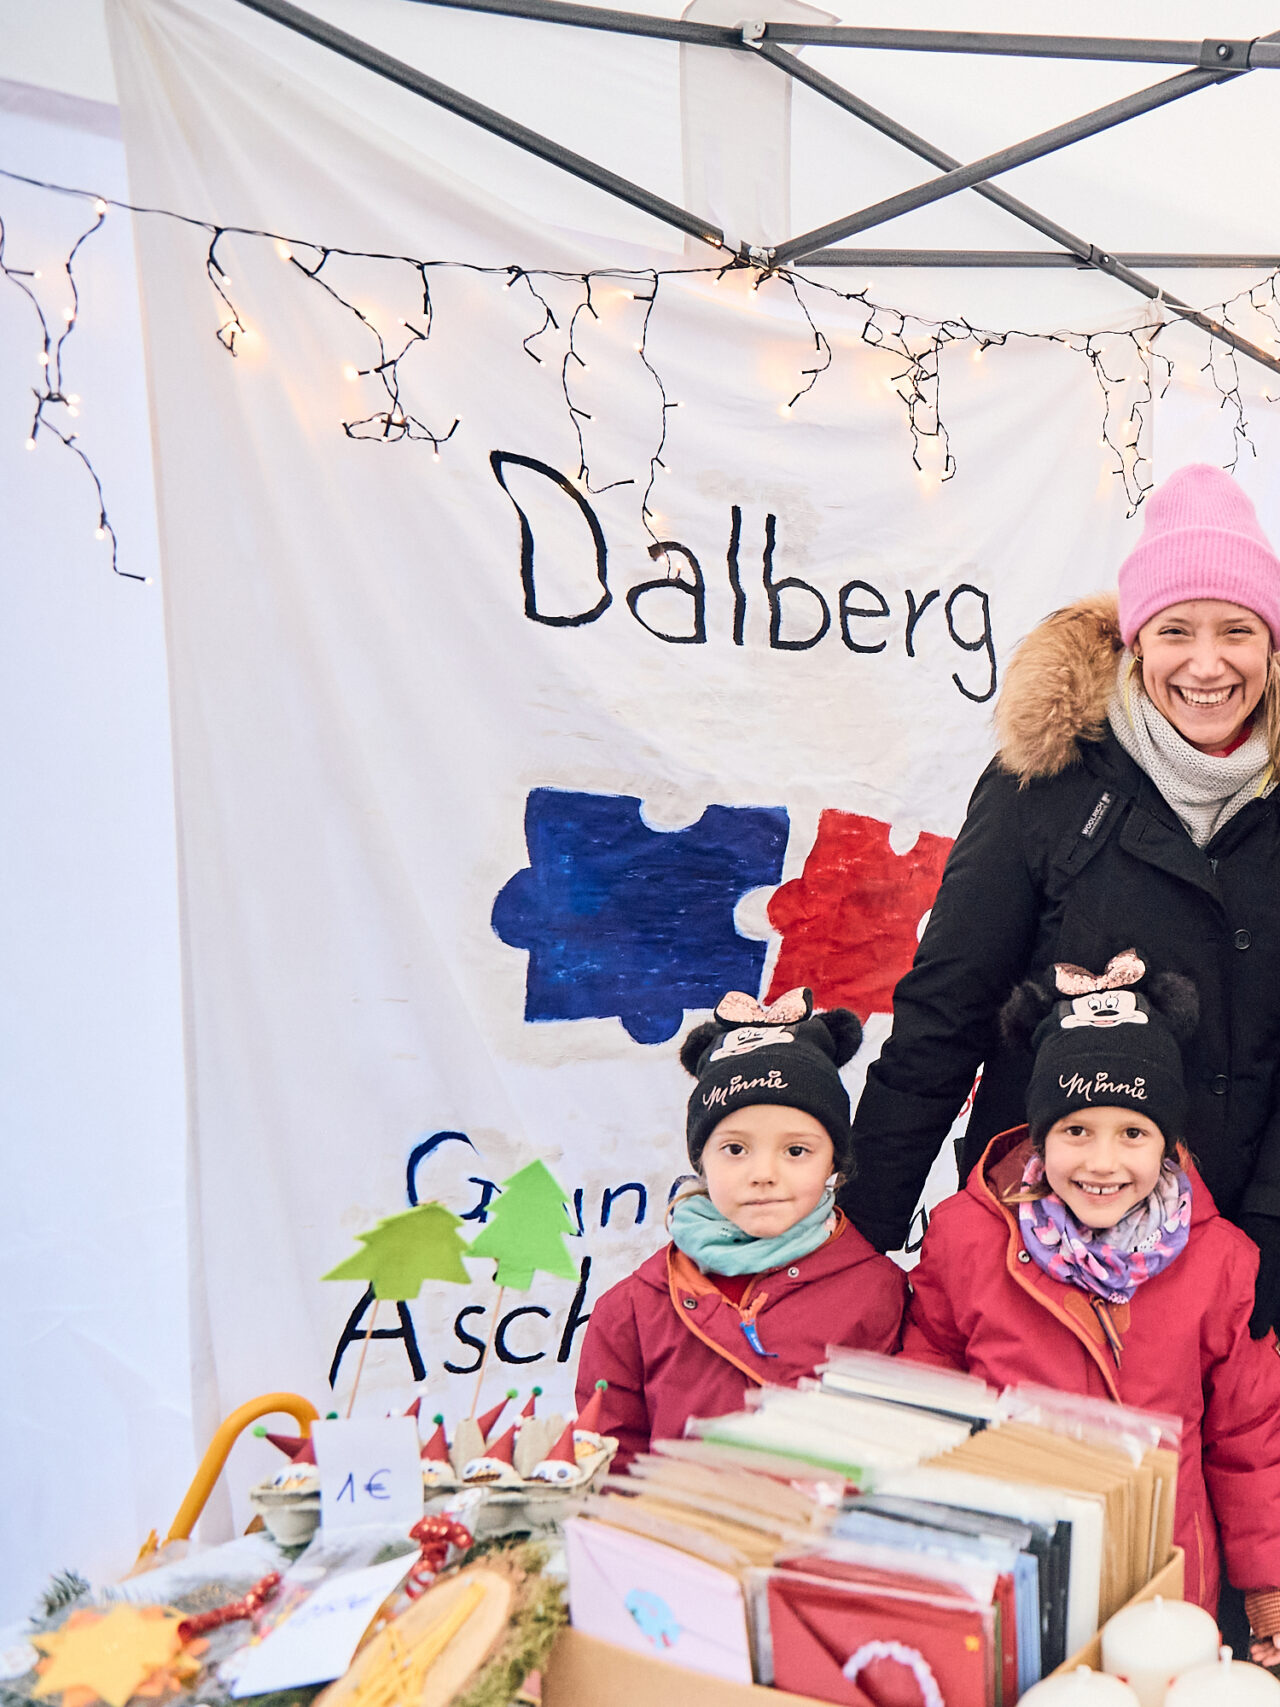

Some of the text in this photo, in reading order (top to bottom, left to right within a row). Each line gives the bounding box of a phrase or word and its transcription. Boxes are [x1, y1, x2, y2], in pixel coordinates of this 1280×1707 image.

[489, 449, 998, 703] Dalberg
[702, 1070, 789, 1111] Minnie
[1058, 1071, 1148, 1102] Minnie
